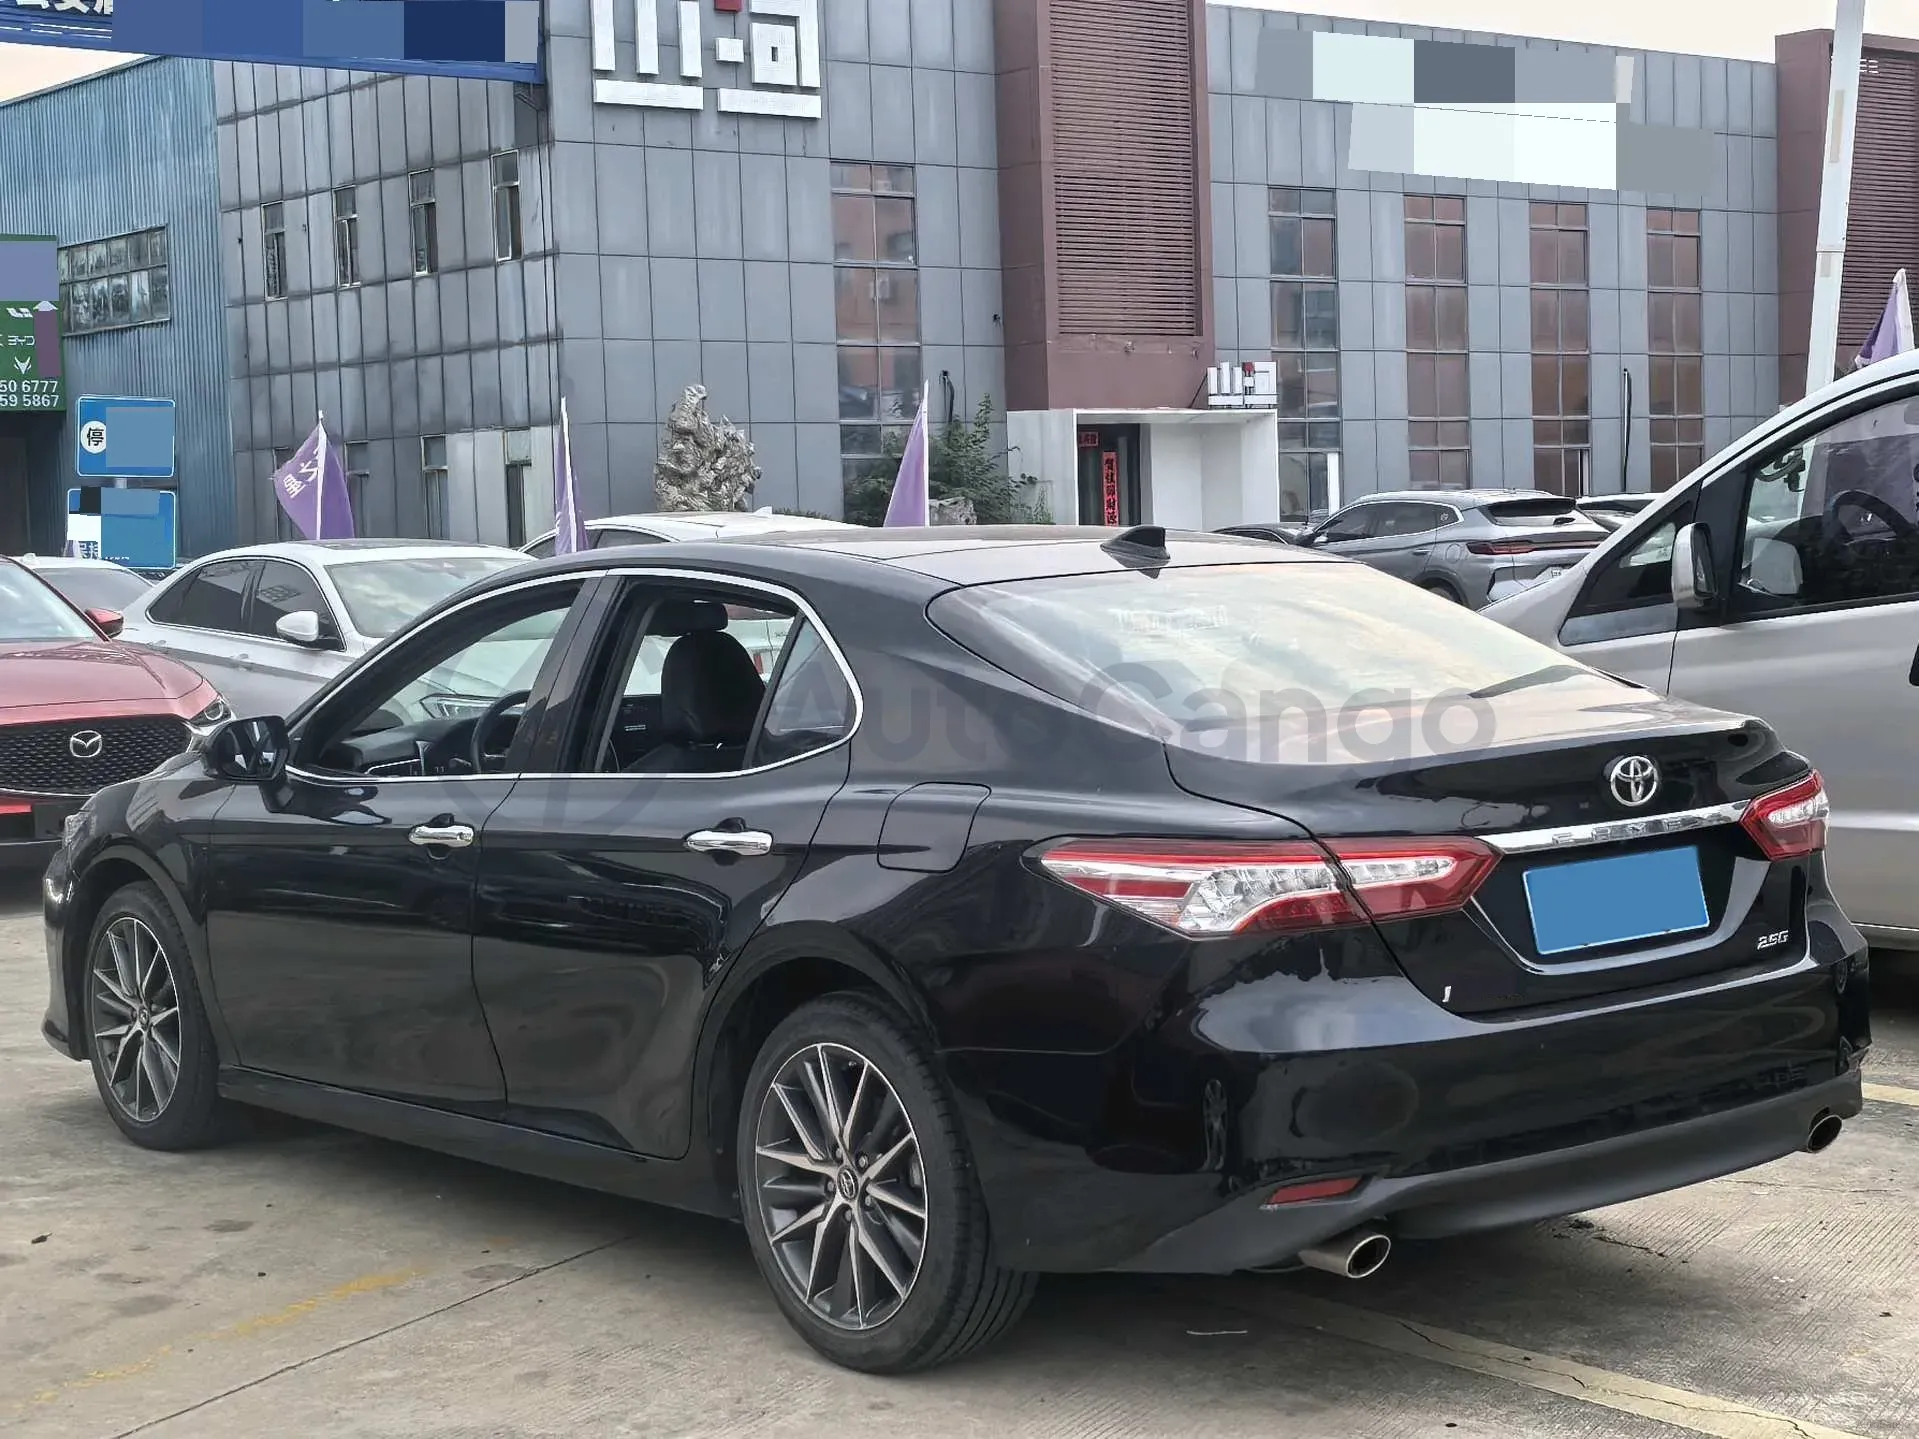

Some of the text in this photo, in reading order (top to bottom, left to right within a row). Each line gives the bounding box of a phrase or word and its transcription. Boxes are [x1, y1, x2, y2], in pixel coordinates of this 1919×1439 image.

[22, 380, 58, 393] 6777
[23, 395, 59, 407] 5867
[87, 428, 105, 446] 停
